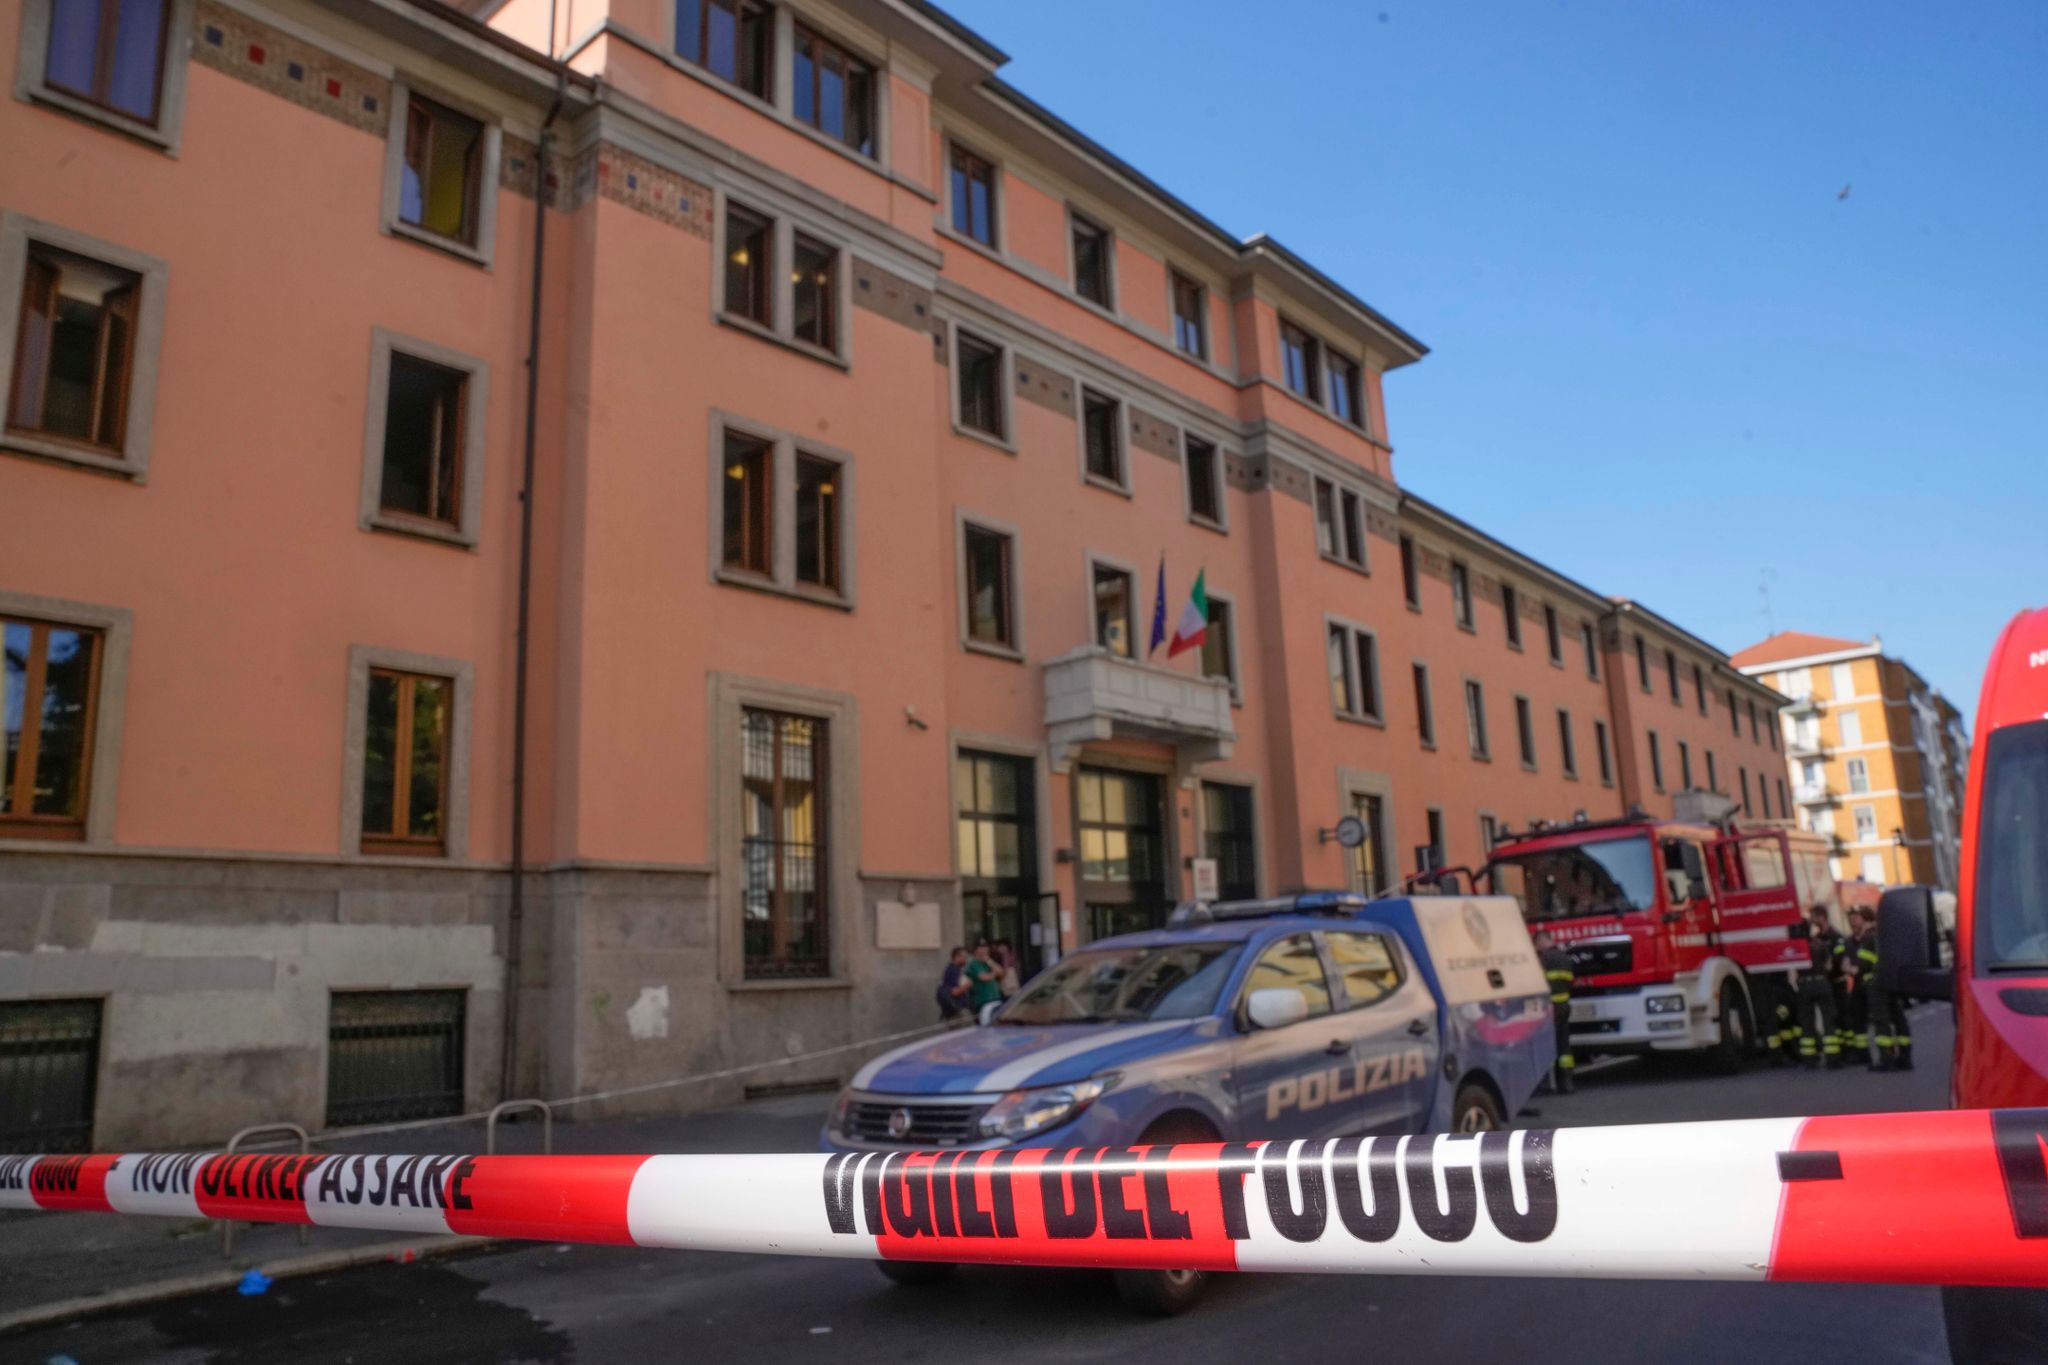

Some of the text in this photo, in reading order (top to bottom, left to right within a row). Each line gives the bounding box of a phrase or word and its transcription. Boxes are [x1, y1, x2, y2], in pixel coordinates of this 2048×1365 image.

[1266, 1048, 1427, 1121] POLIZIA
[132, 1153, 203, 1195] NON
[823, 1147, 1019, 1238] VIGILI
[1038, 1143, 1194, 1241] DEL
[1216, 1128, 1559, 1244] FUOCO
